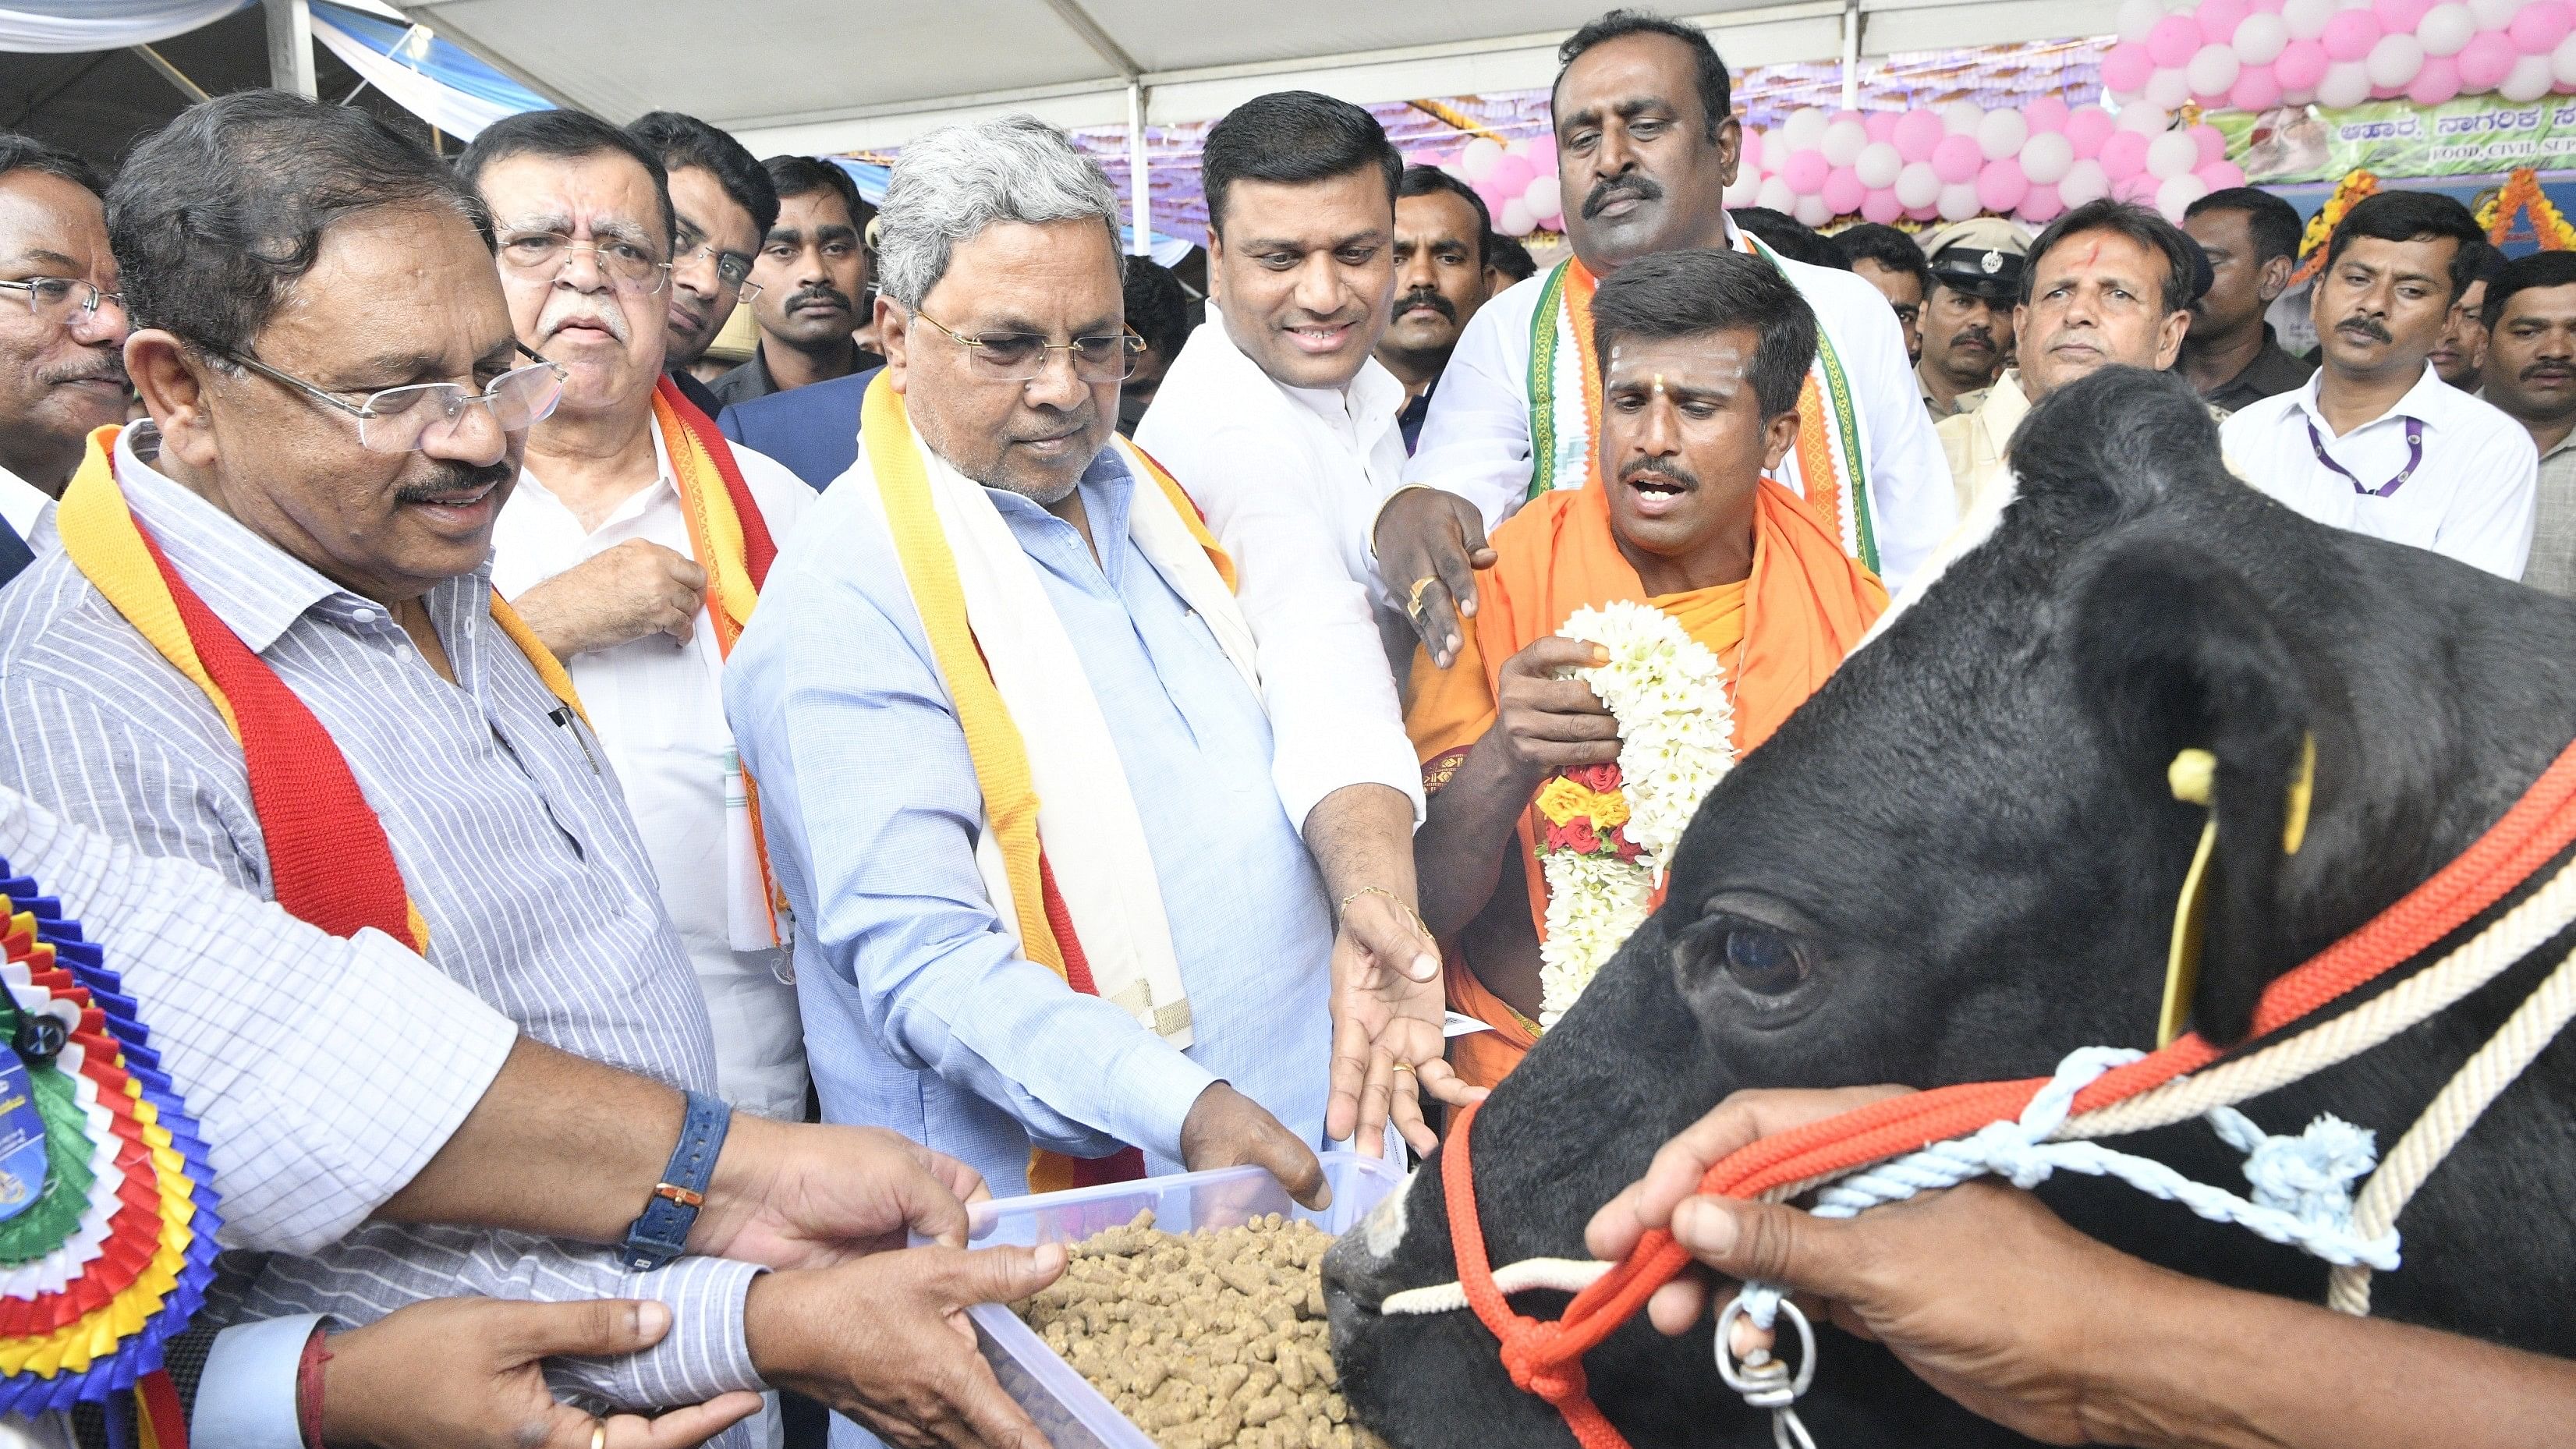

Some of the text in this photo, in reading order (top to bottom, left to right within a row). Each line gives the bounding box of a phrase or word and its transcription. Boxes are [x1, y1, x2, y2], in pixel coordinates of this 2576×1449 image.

[2438, 107, 2539, 133] ನಾಗರಿಕ
[2432, 145, 2484, 159] FOOD,
[2488, 143, 2536, 154] CIVIL
